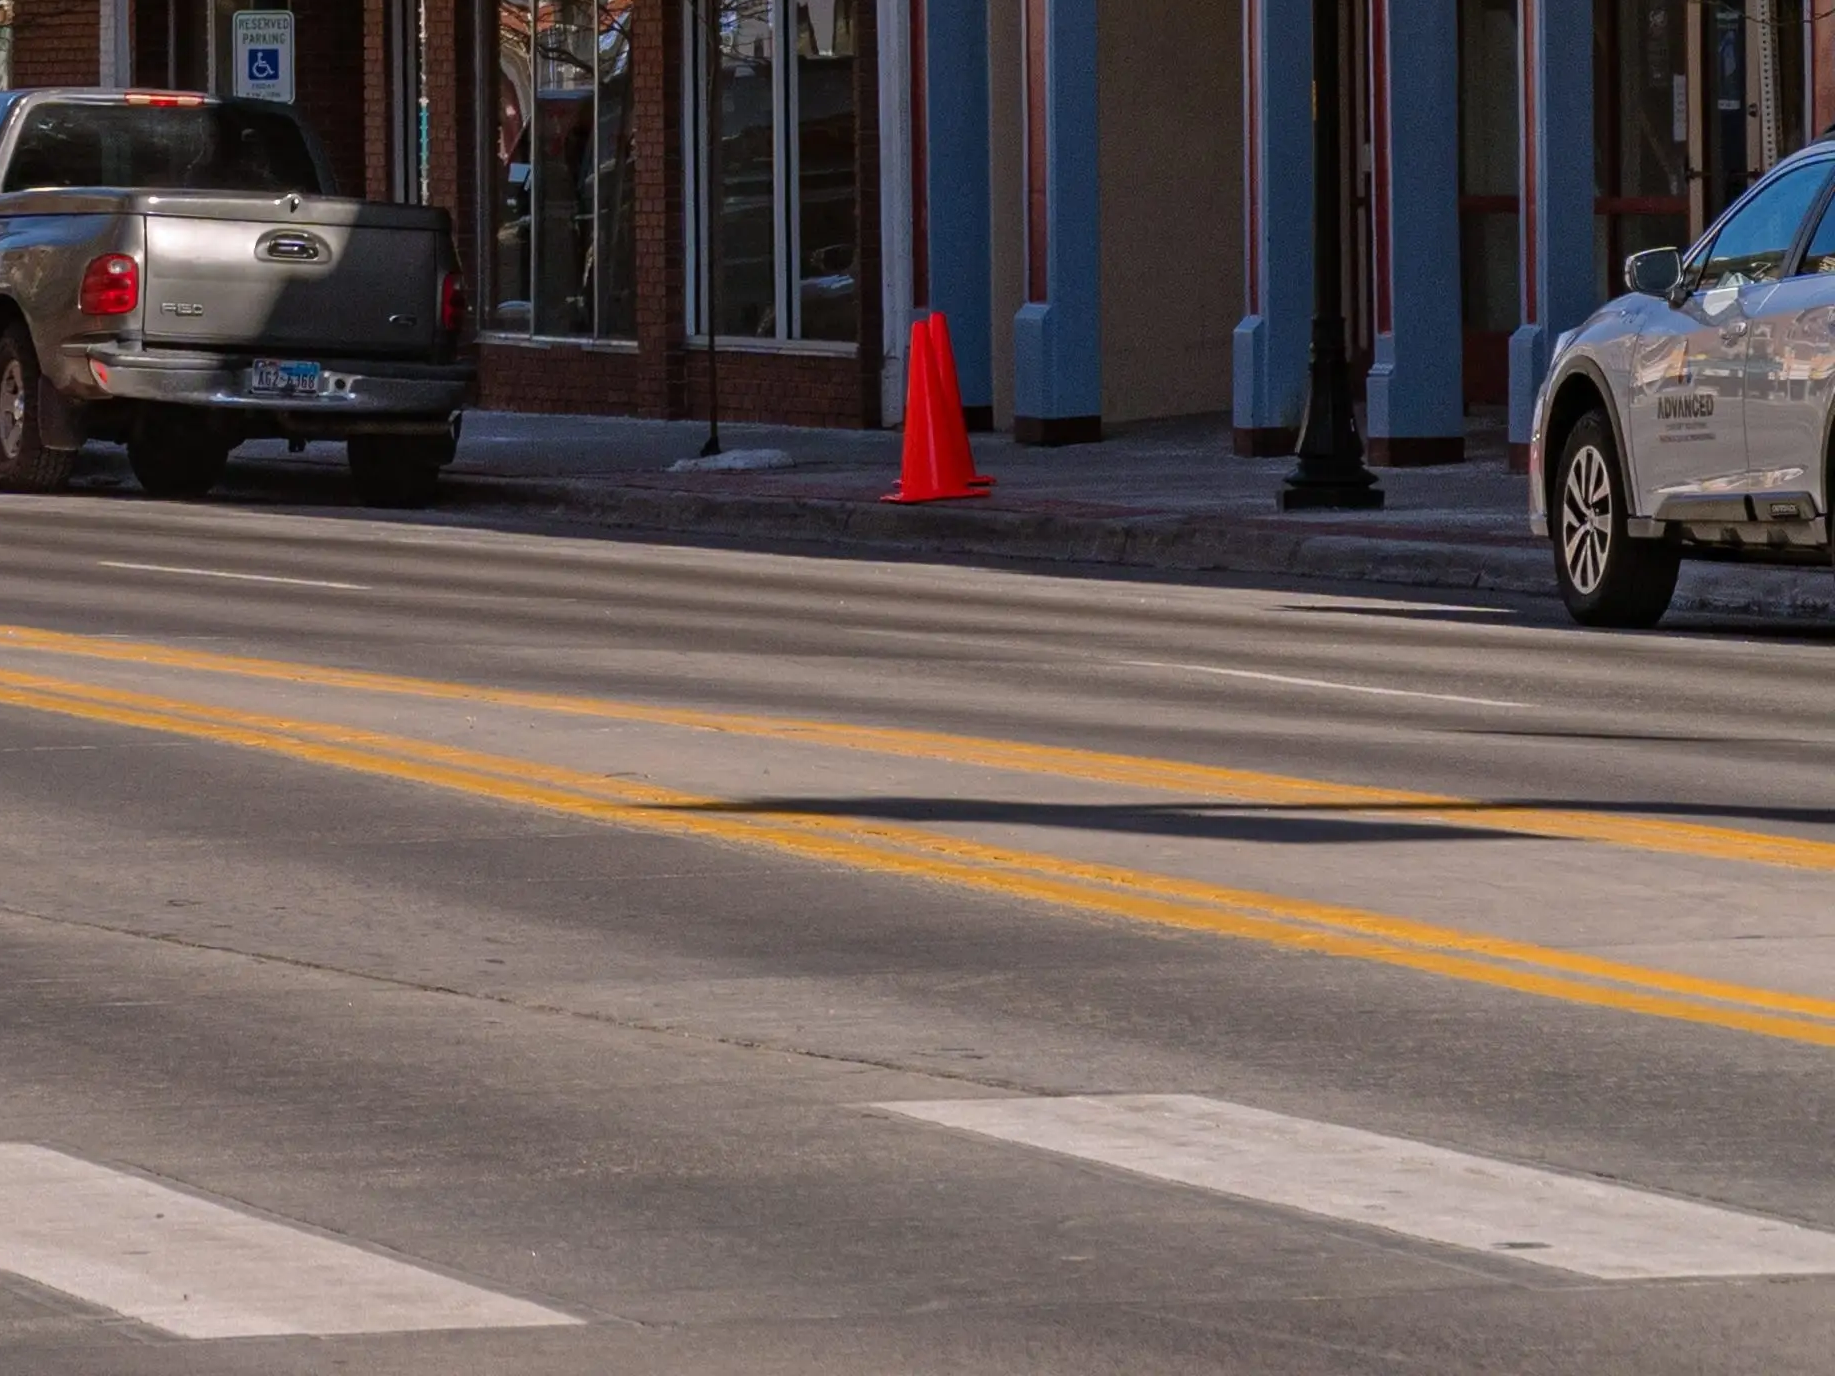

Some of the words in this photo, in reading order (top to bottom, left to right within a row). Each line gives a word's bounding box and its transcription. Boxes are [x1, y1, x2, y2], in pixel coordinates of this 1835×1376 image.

[238, 17, 289, 30] RESERVED
[242, 33, 287, 45] PARKING
[1657, 394, 1714, 419] ADVANCED
